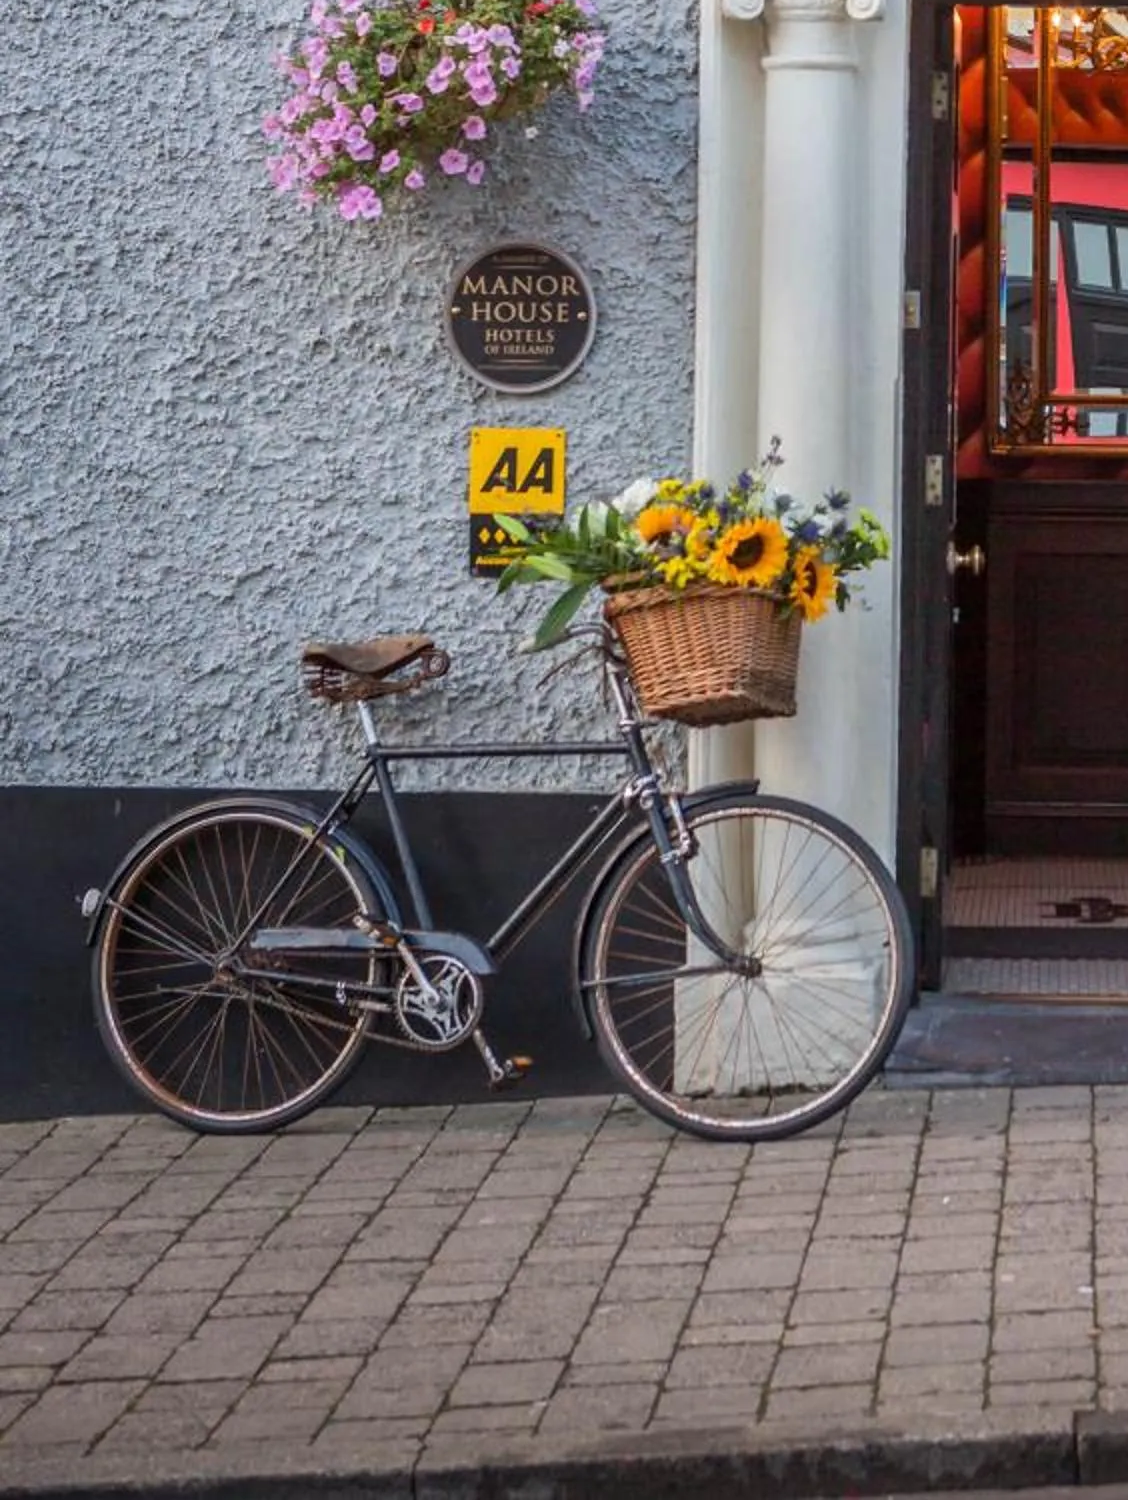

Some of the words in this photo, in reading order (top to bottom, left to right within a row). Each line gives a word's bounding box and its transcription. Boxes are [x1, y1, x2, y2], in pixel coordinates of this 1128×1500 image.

[462, 275, 580, 296] MANOR
[471, 301, 570, 323] HOUSE
[484, 328, 555, 343] HOTELS
[484, 344, 500, 355] OF
[480, 447, 555, 494] AA
